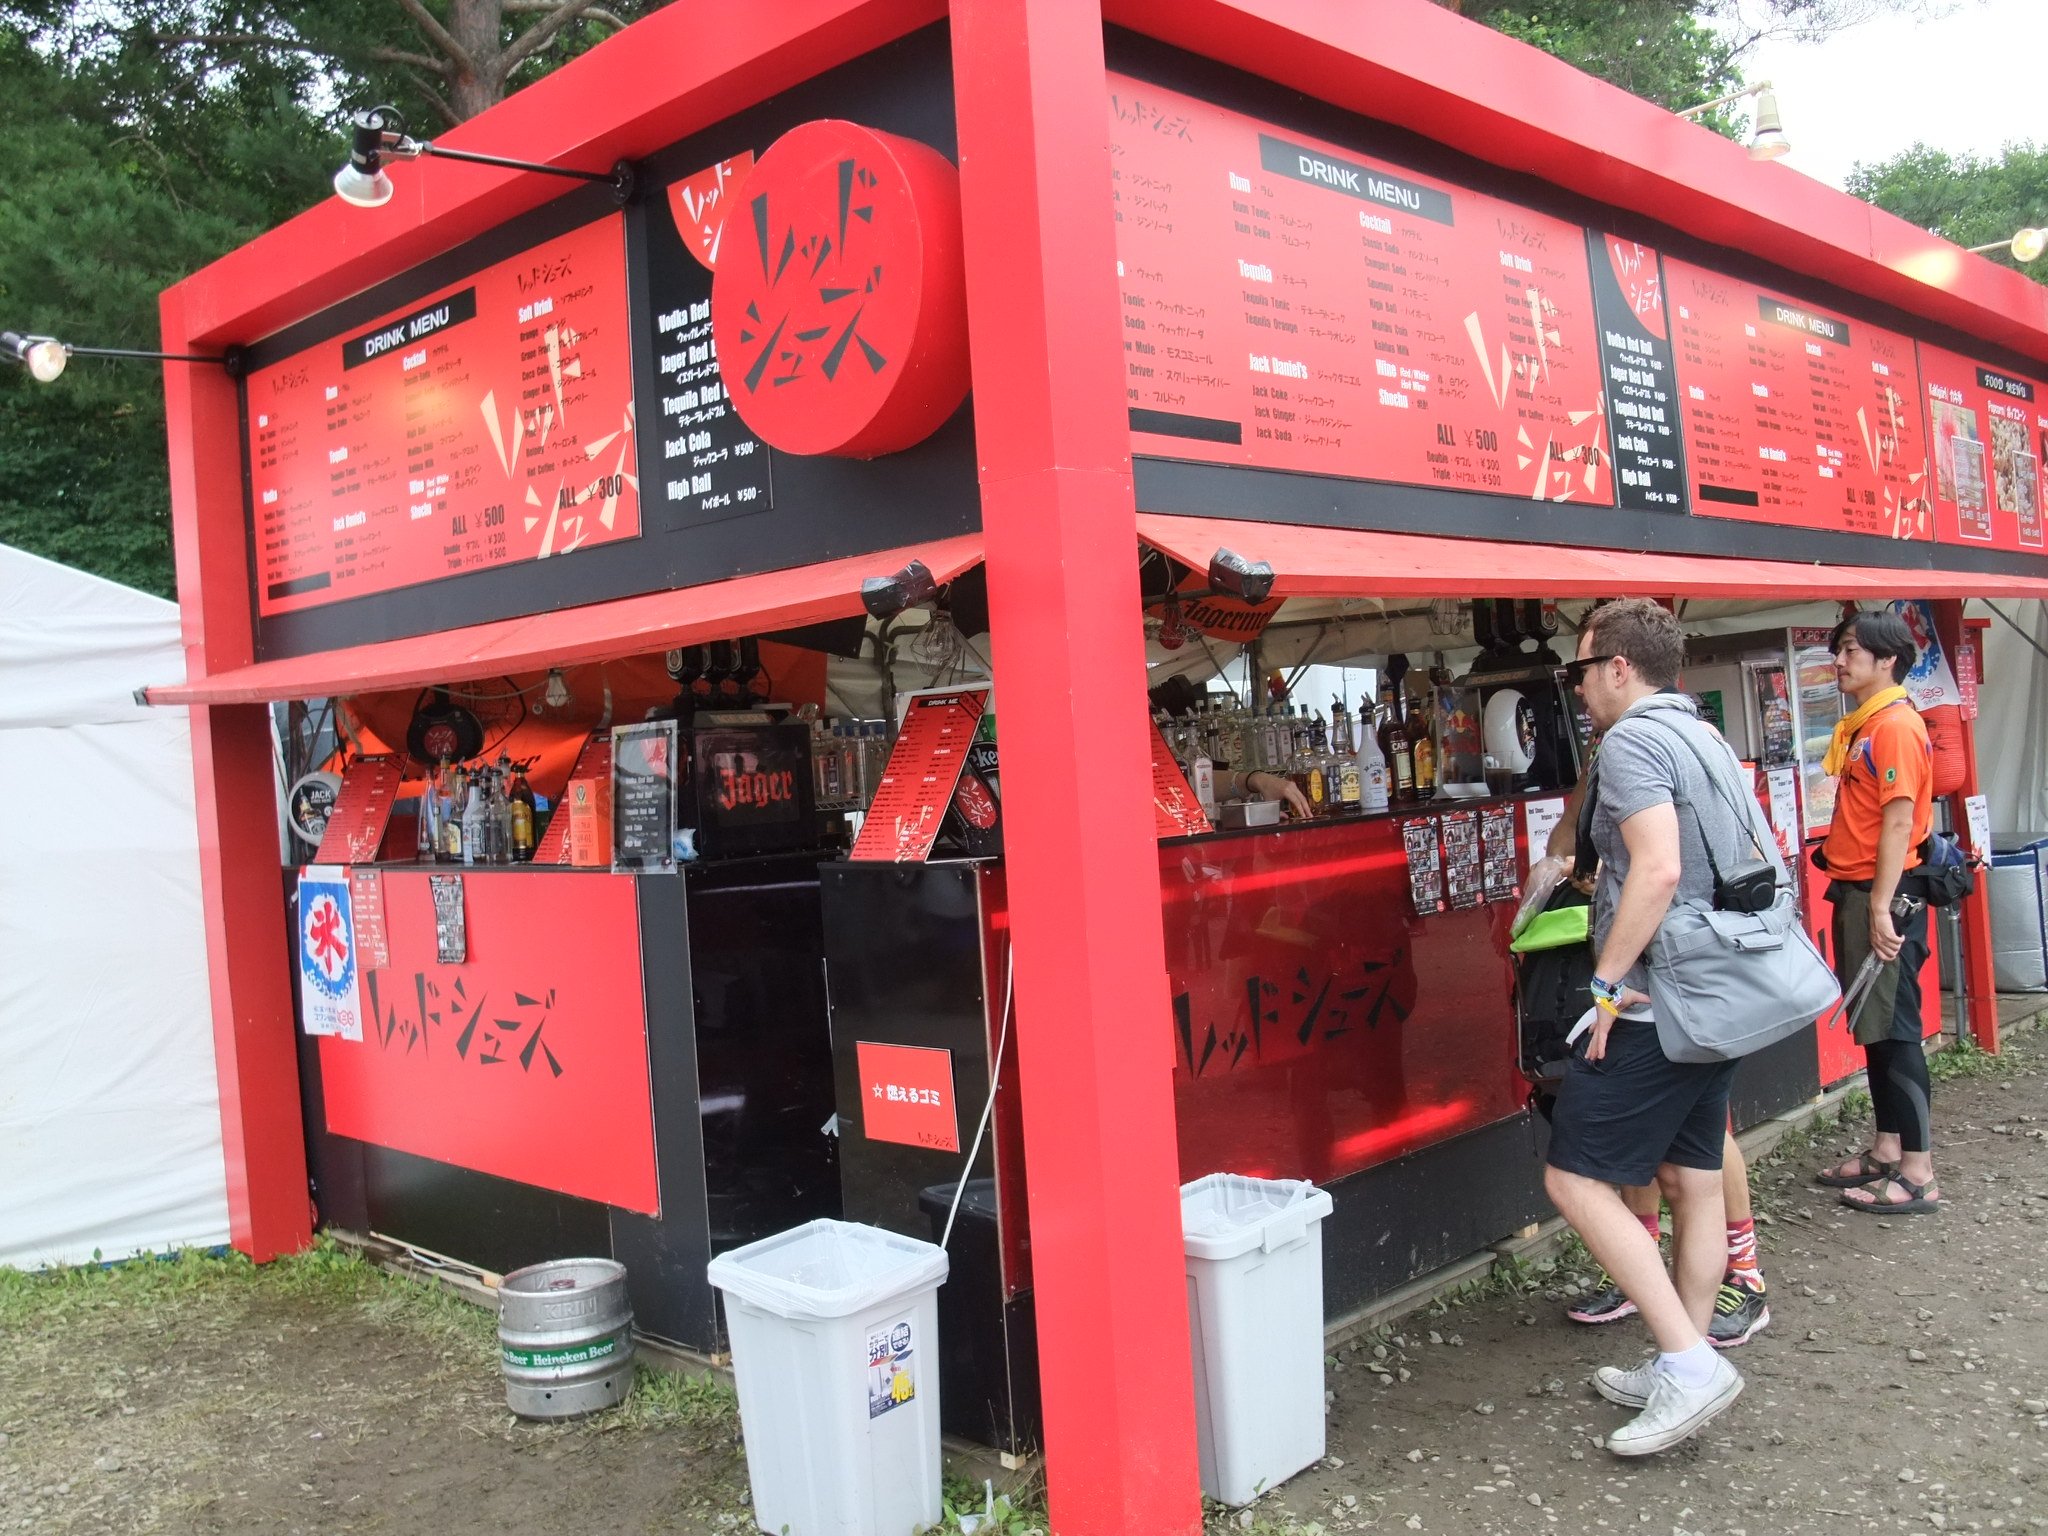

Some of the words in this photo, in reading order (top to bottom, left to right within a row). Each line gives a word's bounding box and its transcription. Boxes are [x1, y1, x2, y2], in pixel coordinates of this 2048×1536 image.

[1228, 171, 1251, 193] Rum
[1299, 155, 1360, 192] DRINK
[1368, 177, 1420, 210] MENU
[751, 158, 877, 293] レッド
[1359, 211, 1392, 234] Cocktail
[1237, 259, 1273, 283] Tequila
[1500, 250, 1513, 267] Soft
[1514, 254, 1533, 273] Drink
[518, 304, 533, 324] Soft
[534, 296, 554, 318] Drink
[1122, 292, 1145, 308] Tonic
[658, 308, 688, 334] Vodka
[690, 299, 709, 323] Red
[1124, 315, 1145, 331] Soda
[1776, 307, 1806, 330] DRINK
[1808, 317, 1834, 338] MENU
[365, 325, 406, 357] DRINK
[410, 305, 450, 338] MENU
[740, 264, 887, 395] シューズ
[1135, 340, 1156, 356] Mule
[1606, 331, 1626, 350] Vodka
[1627, 336, 1640, 353] Red
[1640, 339, 1653, 356] Bull
[660, 351, 687, 374] Jager
[689, 344, 709, 367] Red
[1130, 363, 1154, 378] Driver
[1249, 353, 1270, 373] Jack
[1272, 356, 1308, 379] Daniel's
[1376, 358, 1397, 378] Wine
[1400, 367, 1411, 379] Red
[1610, 364, 1628, 382] Jager
[1628, 368, 1641, 385] Red
[1642, 371, 1655, 388] Bull
[1984, 374, 2004, 390] FOOD
[663, 389, 698, 416] Tequila
[700, 383, 720, 404] Red
[1252, 384, 1268, 398] Jack
[1378, 388, 1409, 409] Shochu
[1255, 405, 1270, 419] Jack
[1614, 399, 1638, 418] Tequila
[1638, 404, 1651, 420] Red
[1652, 406, 1664, 423] Bull
[665, 438, 686, 459] Jack
[689, 431, 711, 450] Cola
[1256, 426, 1272, 439] Jack
[1274, 428, 1292, 442] Soda
[1437, 423, 1456, 447] ALL
[1464, 428, 1498, 452] ¥500
[1618, 434, 1633, 450] Jack
[1634, 437, 1648, 453] Cola
[1427, 451, 1449, 465] Double
[1550, 441, 1565, 462] ALL
[1432, 467, 1451, 480] Triple
[1622, 468, 1637, 486] High
[1638, 470, 1651, 487] Ball
[559, 486, 578, 510] ALL
[667, 478, 689, 500] High
[692, 473, 711, 491] Ball
[452, 515, 467, 536] ALL
[475, 504, 504, 528] ¥500
[1795, 630, 1832, 642] POPCOR
[310, 789, 331, 800] JACK
[310, 901, 348, 976] 氷
[366, 969, 564, 1079] レッドシューズ
[1174, 946, 1412, 1080] レッドシューズ
[886, 1084, 941, 1107] 燃えるゴミ
[542, 1295, 598, 1322] KIRIN
[508, 1350, 529, 1366] Beer
[533, 1350, 588, 1366] Heineken
[589, 1342, 615, 1358] Beer
[868, 1341, 889, 1363] 分別
